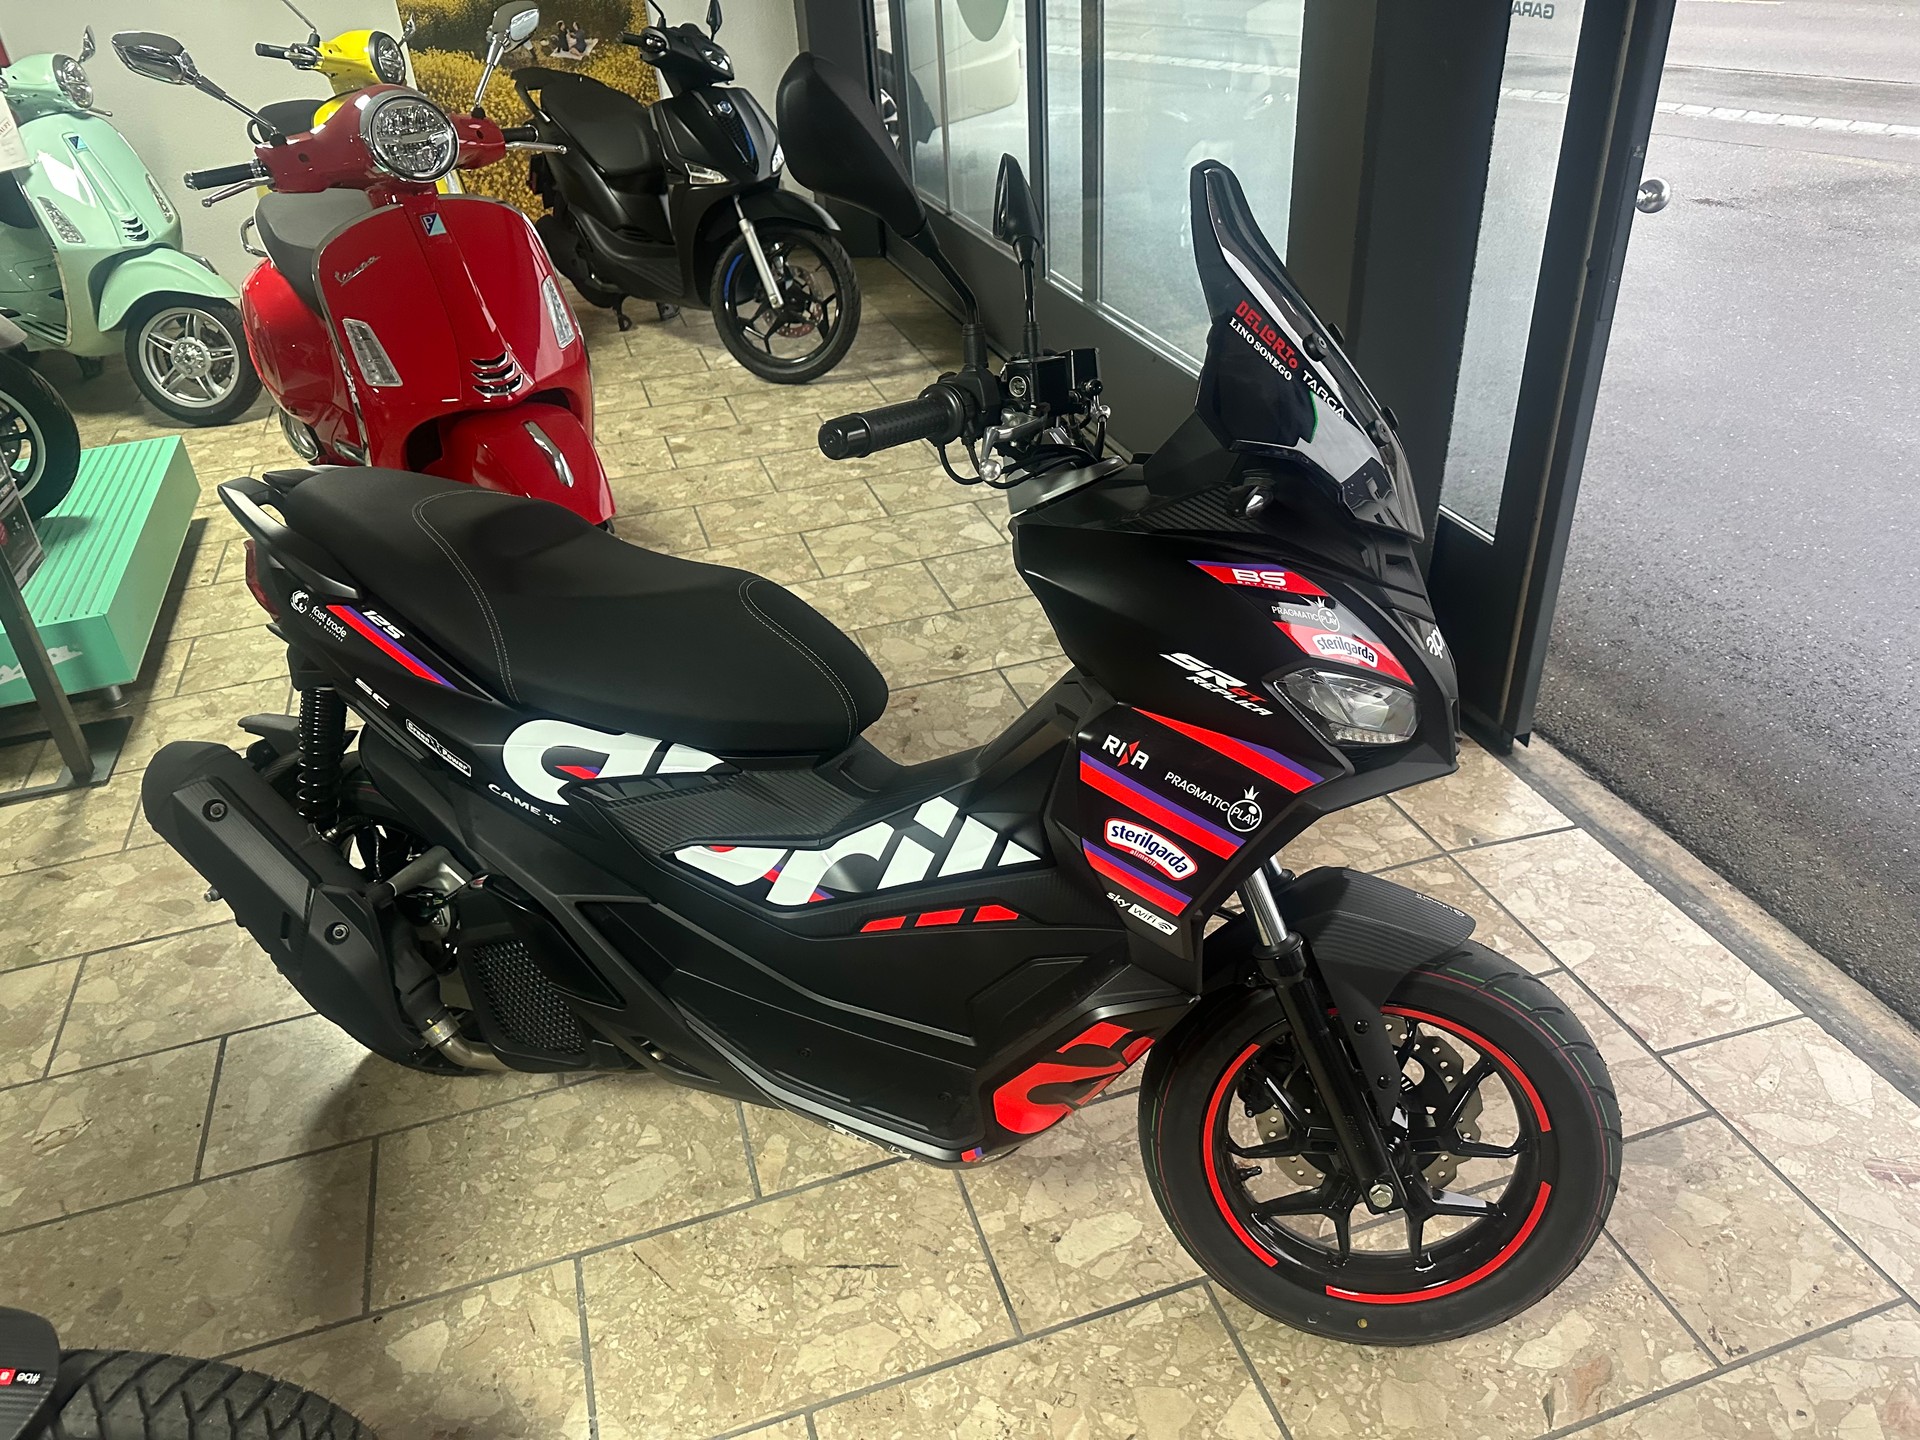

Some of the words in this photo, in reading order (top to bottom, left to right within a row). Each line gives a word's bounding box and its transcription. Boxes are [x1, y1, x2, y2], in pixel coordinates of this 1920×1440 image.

[334, 256, 381, 287] Vespa
[1229, 317, 1255, 345] LINO
[1253, 341, 1293, 381] SONEGO
[1302, 370, 1346, 421] TARGA
[1231, 568, 1287, 587] BS
[311, 605, 327, 622] fast
[326, 616, 347, 638] trade
[362, 610, 405, 639] 125
[1271, 605, 1320, 622] PRAGMATIC
[1320, 614, 1338, 626] PLAY
[1316, 636, 1375, 663] sterilgarda
[1185, 675, 1274, 716] REPLICA
[442, 749, 468, 771] Power
[1102, 734, 1150, 770] RINA
[488, 783, 541, 816] CAME
[1164, 771, 1230, 812] PRAGMATIC
[1230, 806, 1259, 826] PLAY
[1111, 825, 1188, 873] sterilgarda
[1129, 849, 1158, 867] alimenti
[1106, 892, 1131, 908] sky
[1133, 907, 1157, 924] wifi
